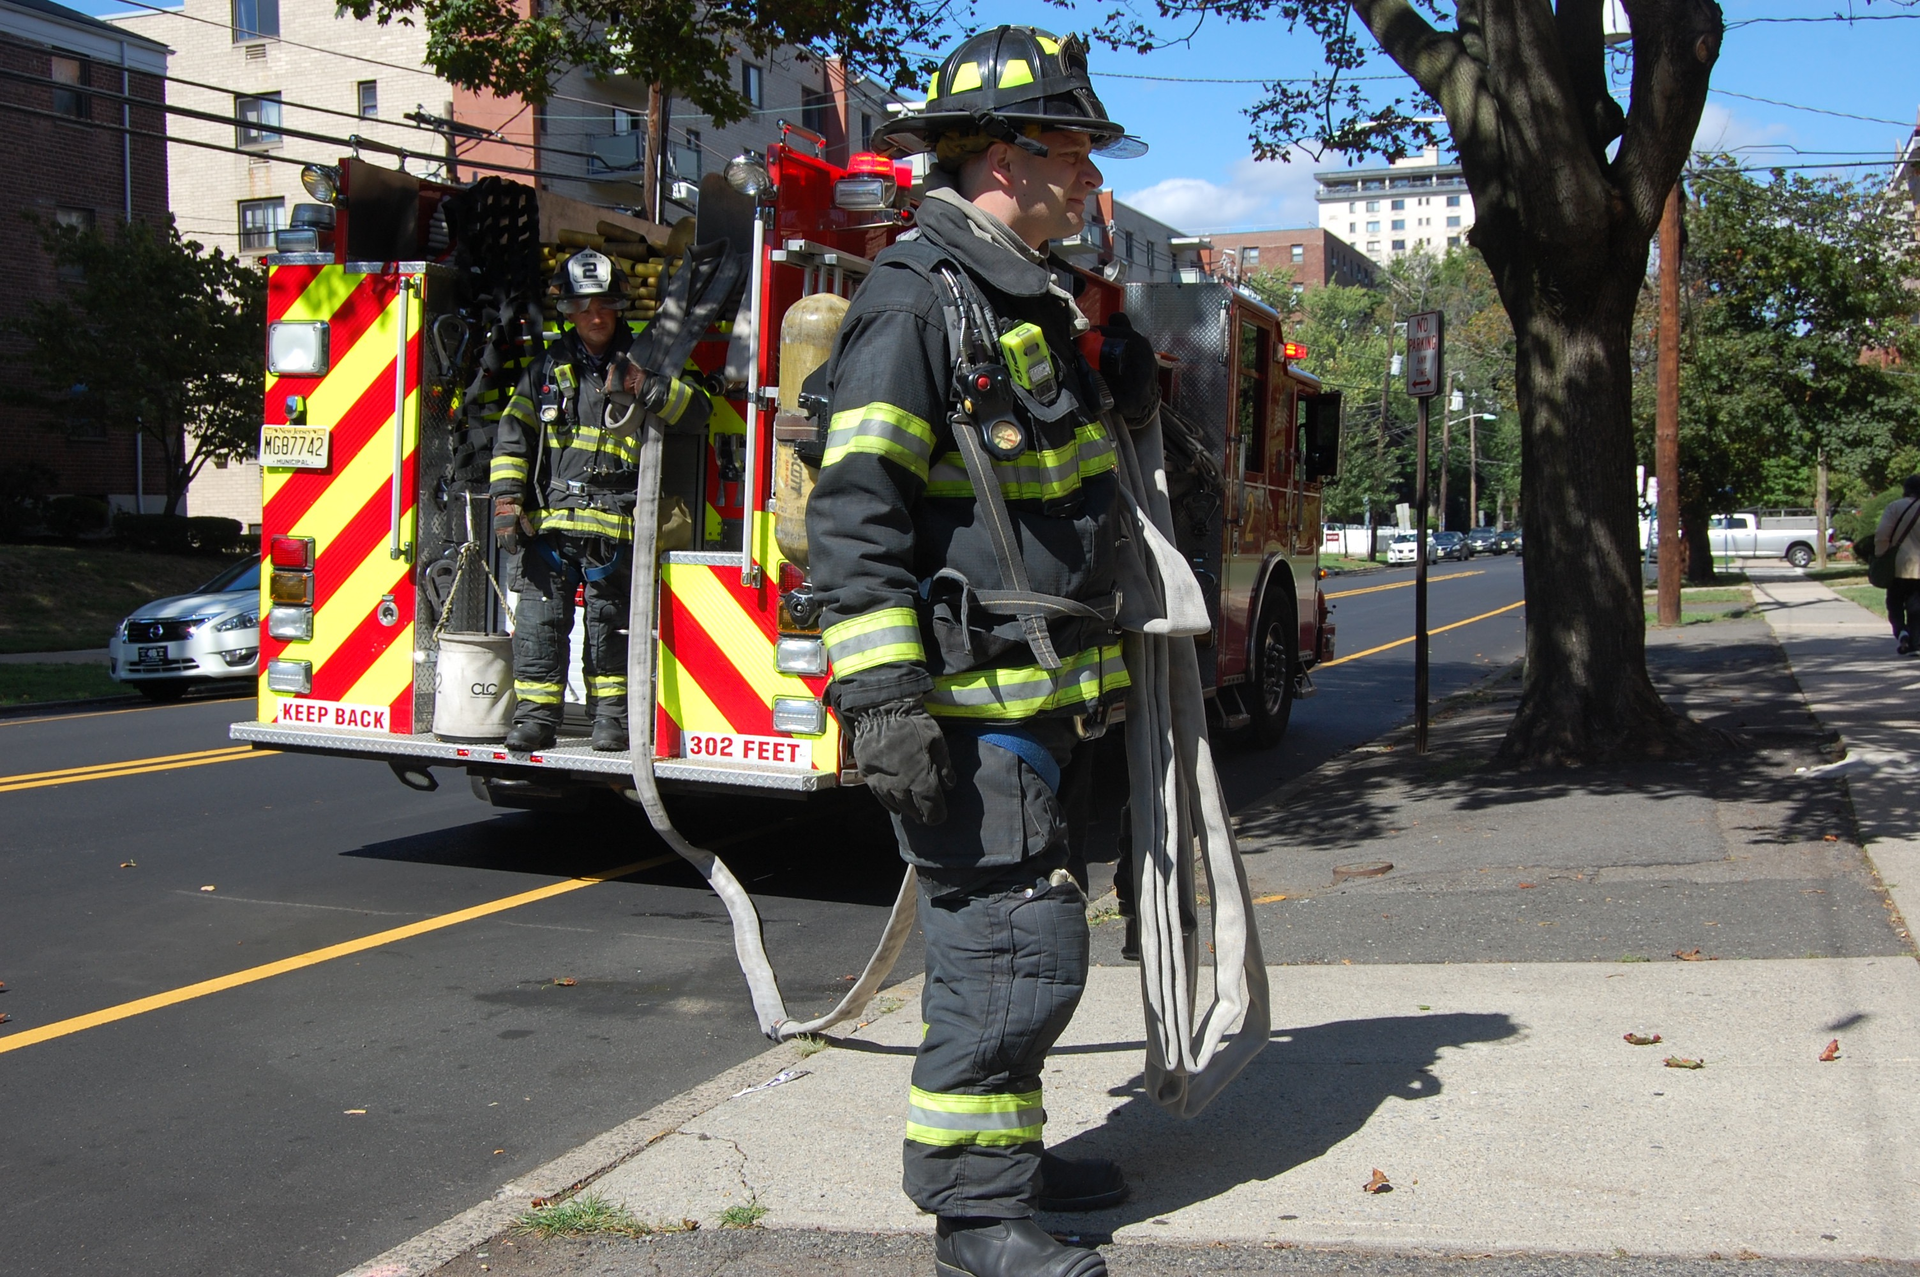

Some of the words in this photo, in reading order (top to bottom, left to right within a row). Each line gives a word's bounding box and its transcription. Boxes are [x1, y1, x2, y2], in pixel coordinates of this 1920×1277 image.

[582, 262, 598, 279] 2
[1417, 317, 1428, 333] NO
[1409, 335, 1437, 353] PARKING
[293, 427, 311, 435] Jersey
[264, 435, 324, 456] MG87742
[1245, 492, 1255, 542] 2
[471, 682, 498, 696] CLC
[283, 703, 328, 723] KEEP
[335, 707, 385, 729] BACK
[690, 736, 733, 757] 302
[743, 740, 800, 763] FEET
